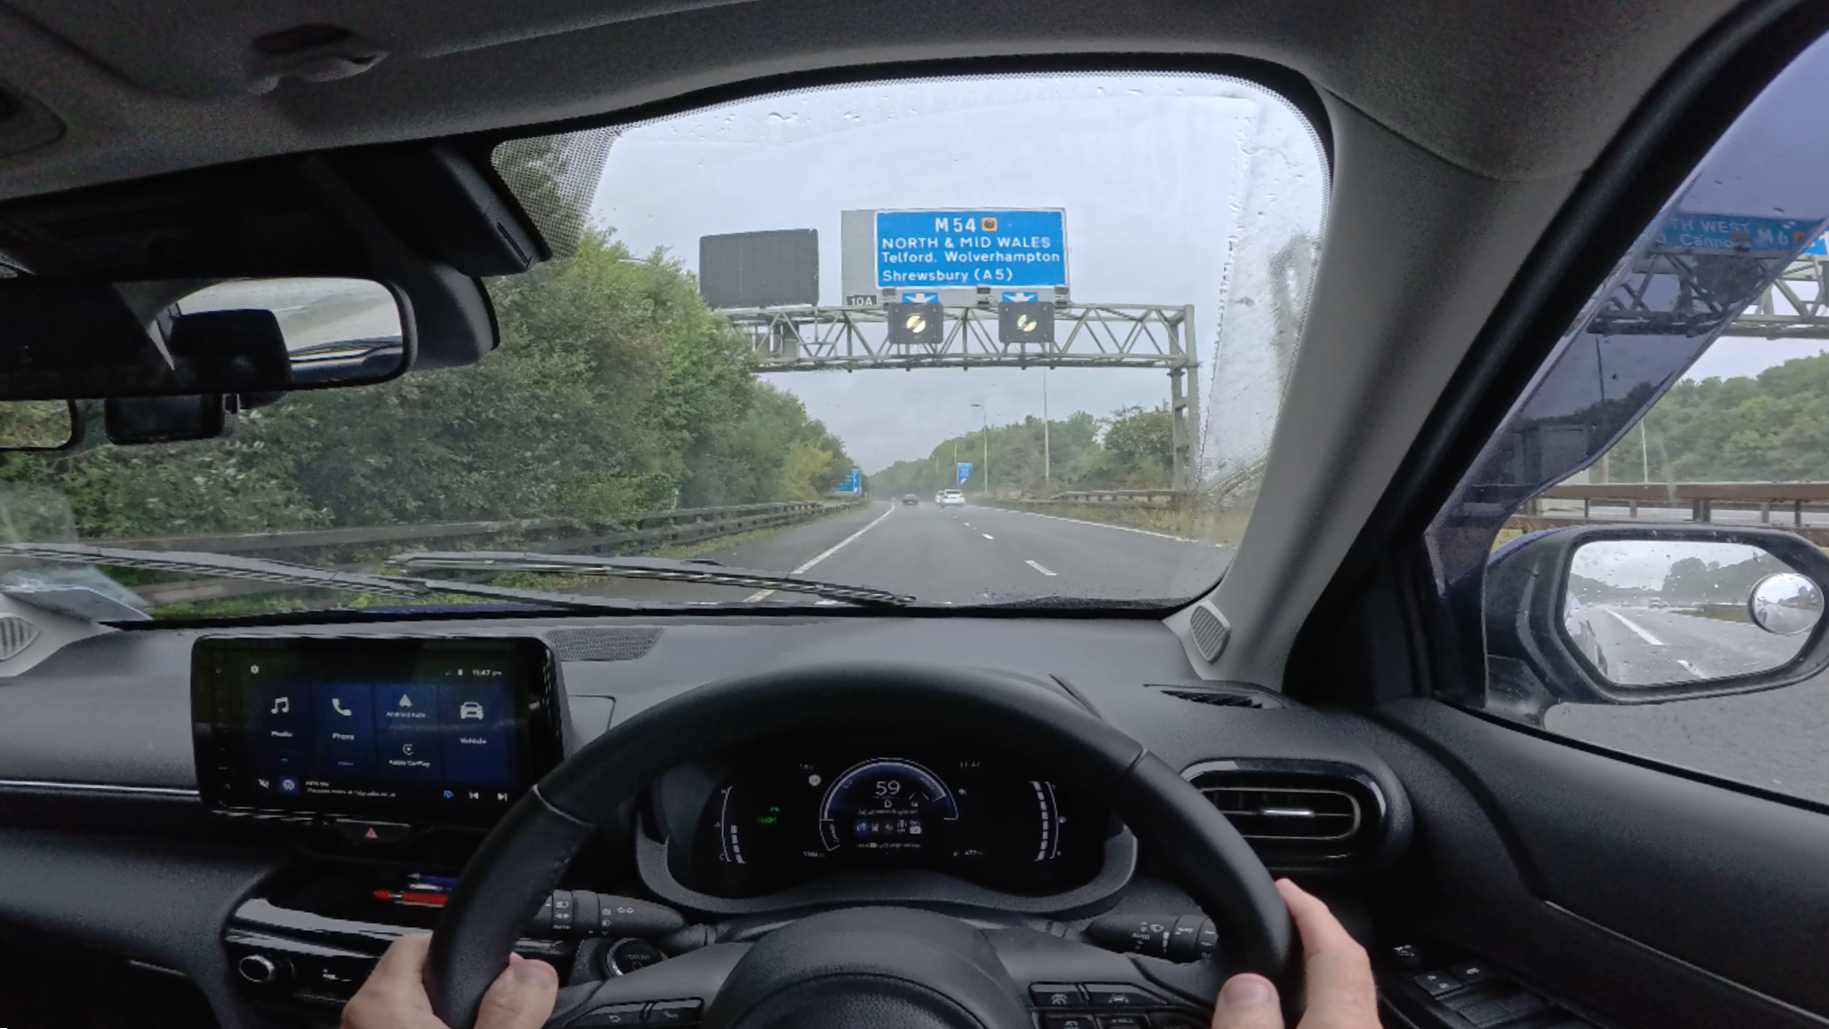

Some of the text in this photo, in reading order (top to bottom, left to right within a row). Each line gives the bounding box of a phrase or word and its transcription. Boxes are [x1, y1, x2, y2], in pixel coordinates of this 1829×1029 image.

[935, 217, 976, 232] M54
[1700, 220, 1751, 234] WEST
[882, 236, 1051, 250] NORTH & MID WALES
[945, 251, 1060, 264] Wolverhampton
[882, 268, 1013, 282] Shrewsbury (A5)
[851, 296, 873, 306] 10A
[875, 780, 901, 796] 59
[883, 799, 893, 808] D
